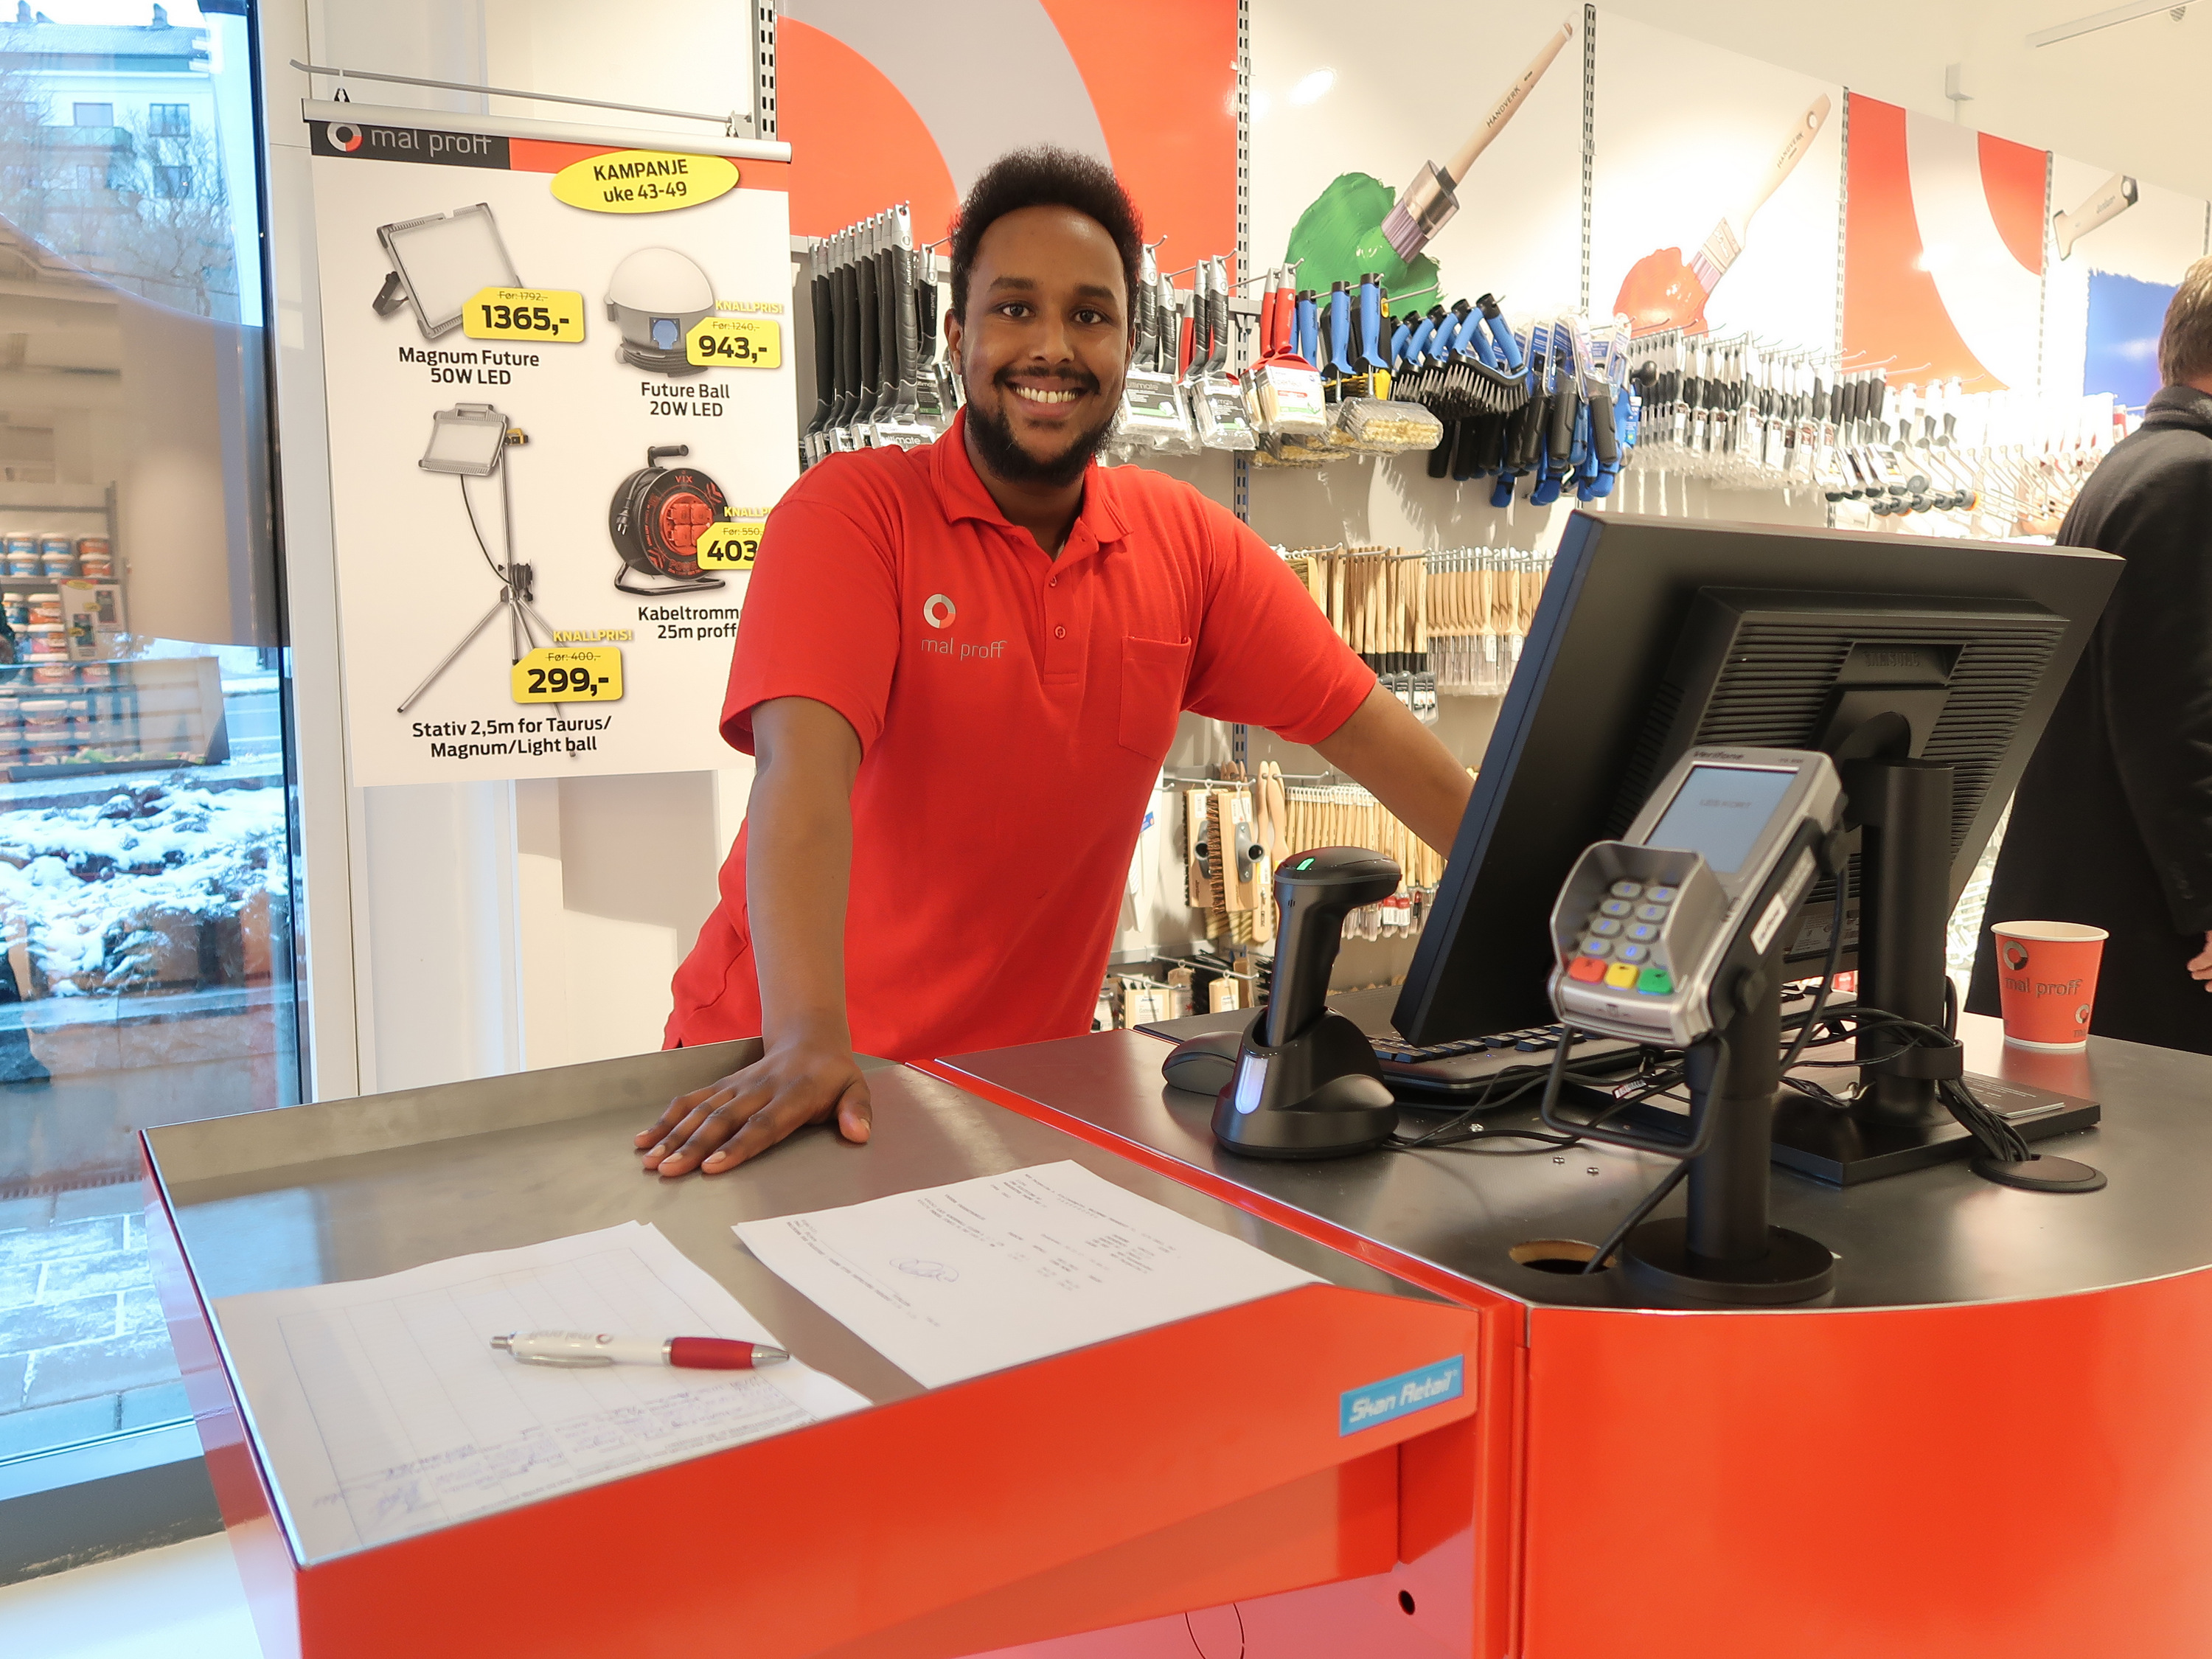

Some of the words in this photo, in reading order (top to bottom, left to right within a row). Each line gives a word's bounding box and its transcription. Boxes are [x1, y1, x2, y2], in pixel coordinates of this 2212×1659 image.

[1486, 86, 1520, 128] HANDVERK
[371, 128, 420, 150] mal
[594, 159, 689, 181] KAMPANJE
[603, 186, 634, 203] uke
[638, 181, 687, 200] 43-49
[498, 291, 518, 300] Før:
[519, 292, 548, 302] 1792,-
[715, 299, 784, 314] KNALLPRIS!
[481, 305, 569, 336] 1365,-
[712, 321, 730, 330] Før:
[732, 322, 760, 331] 1240,-
[398, 347, 478, 366] Magnum
[481, 349, 540, 366] Future
[698, 335, 768, 364] 943,-
[431, 368, 473, 384] 50W
[478, 369, 512, 385] LED
[641, 382, 695, 398] Future
[698, 383, 731, 399] Ball
[650, 400, 688, 416] 20W
[692, 402, 723, 417] LED
[723, 527, 741, 535] Før:
[707, 540, 758, 561] 403
[638, 605, 740, 621] Kabeltromm
[553, 629, 633, 642] KNALLPRIS!
[657, 625, 694, 639] 25m
[697, 622, 737, 641] proff
[548, 653, 568, 661] Før:
[571, 652, 601, 661] 400,-
[921, 637, 954, 655] mal
[960, 640, 1008, 661] proff
[527, 667, 609, 697] 299,-
[412, 722, 467, 737] Stativ
[470, 720, 515, 737] 2,5m
[518, 718, 543, 733] for
[546, 715, 612, 732] Taurus/
[431, 738, 563, 759] Magnum/Light
[565, 736, 597, 751] ball
[2005, 977, 2030, 992] mal
[2036, 979, 2083, 998] proff
[1349, 1394, 1397, 1423] Skan
